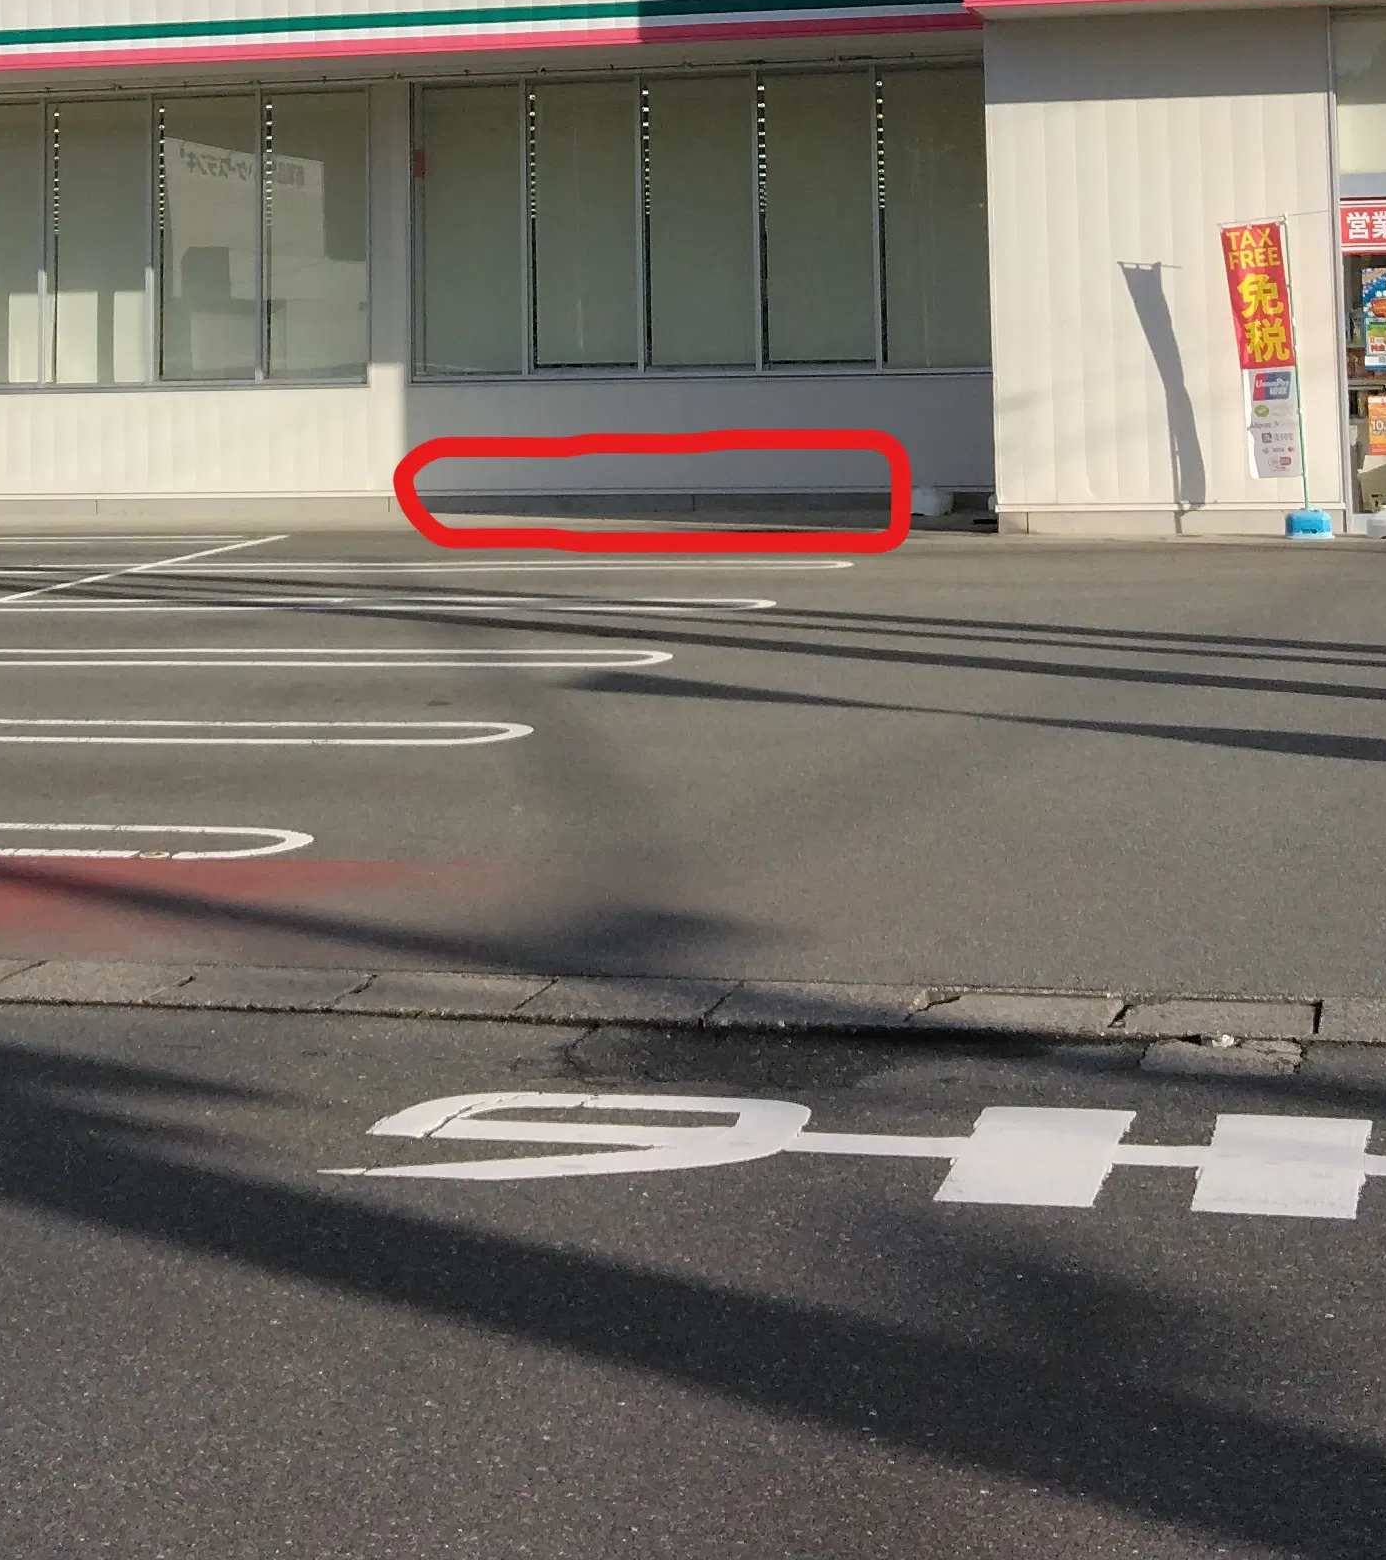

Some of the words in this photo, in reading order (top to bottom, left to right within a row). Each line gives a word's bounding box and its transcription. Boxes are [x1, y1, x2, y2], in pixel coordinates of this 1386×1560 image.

[1226, 226, 1274, 251] TAX
[1228, 246, 1281, 270] FREE
[1237, 272, 1290, 363] 免税
